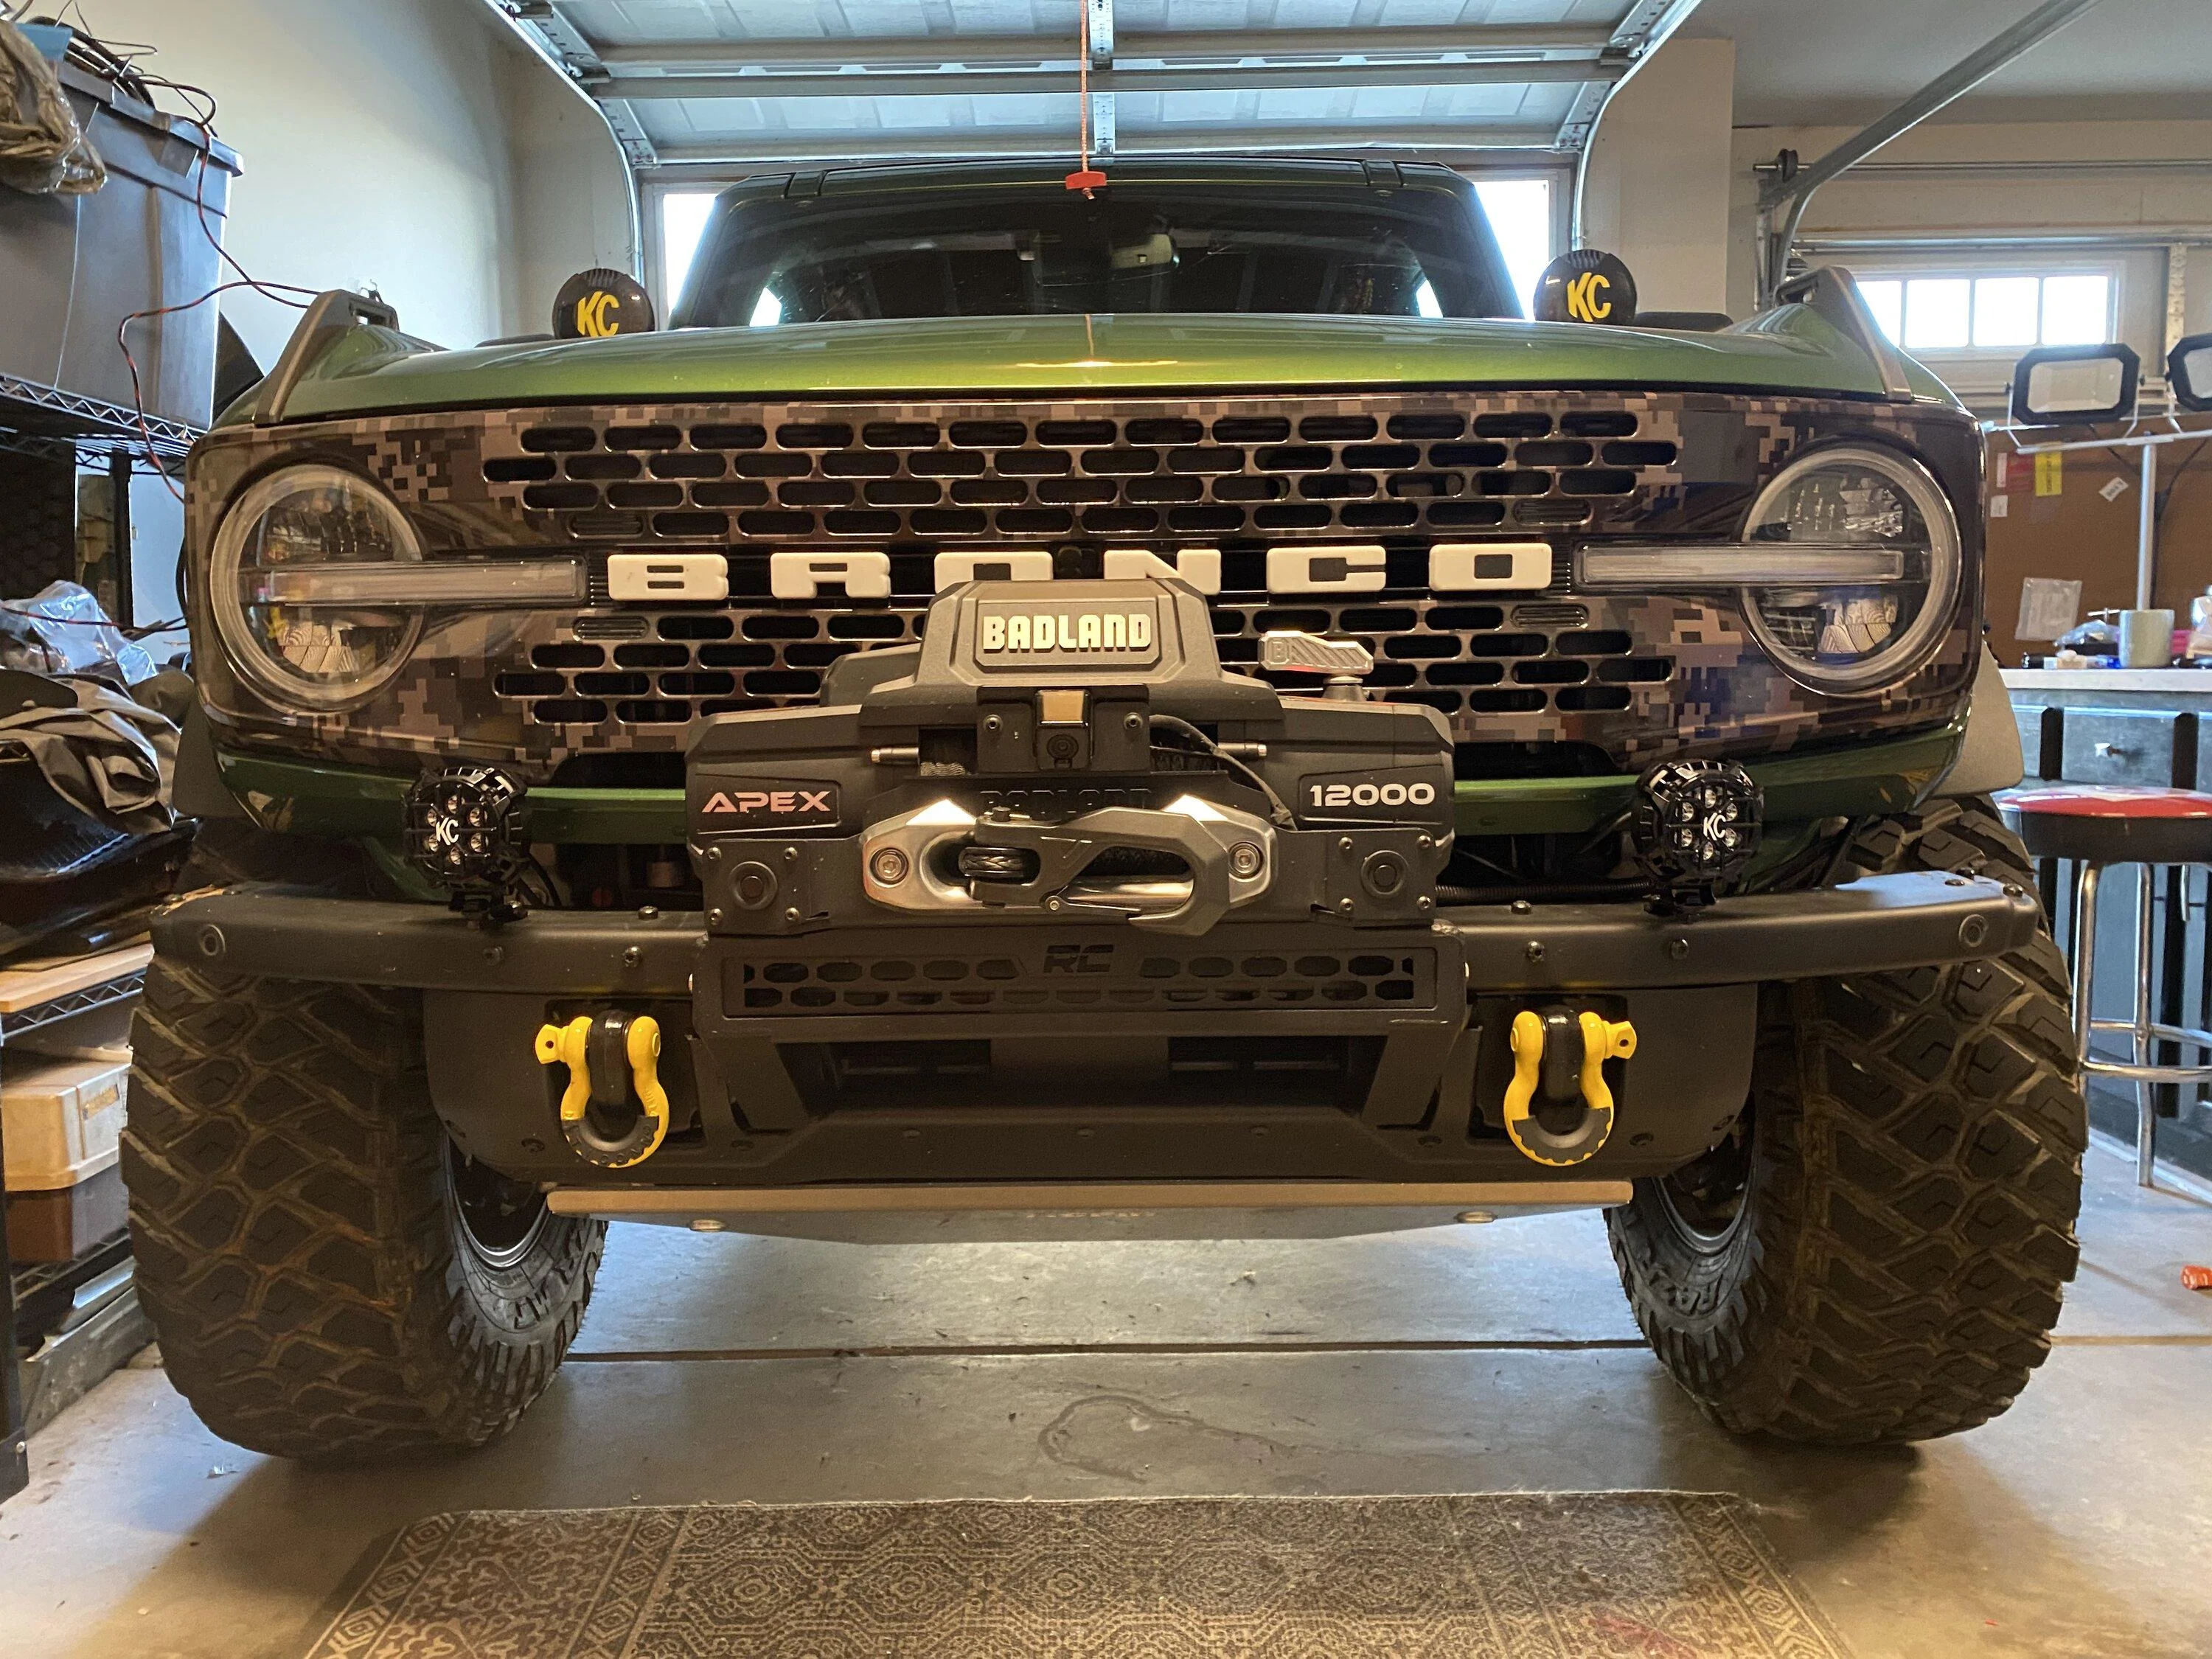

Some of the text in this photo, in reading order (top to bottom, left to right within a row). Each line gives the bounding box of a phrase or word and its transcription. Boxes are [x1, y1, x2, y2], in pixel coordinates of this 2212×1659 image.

[1567, 271, 1612, 323] KC
[577, 291, 620, 338] KC
[983, 613, 1152, 652] BADLAND
[702, 790, 831, 813] APEX
[1309, 783, 1436, 807] 12000
[435, 816, 459, 846] KC
[1703, 812, 1727, 841] KC
[1043, 945, 1114, 973] RC
